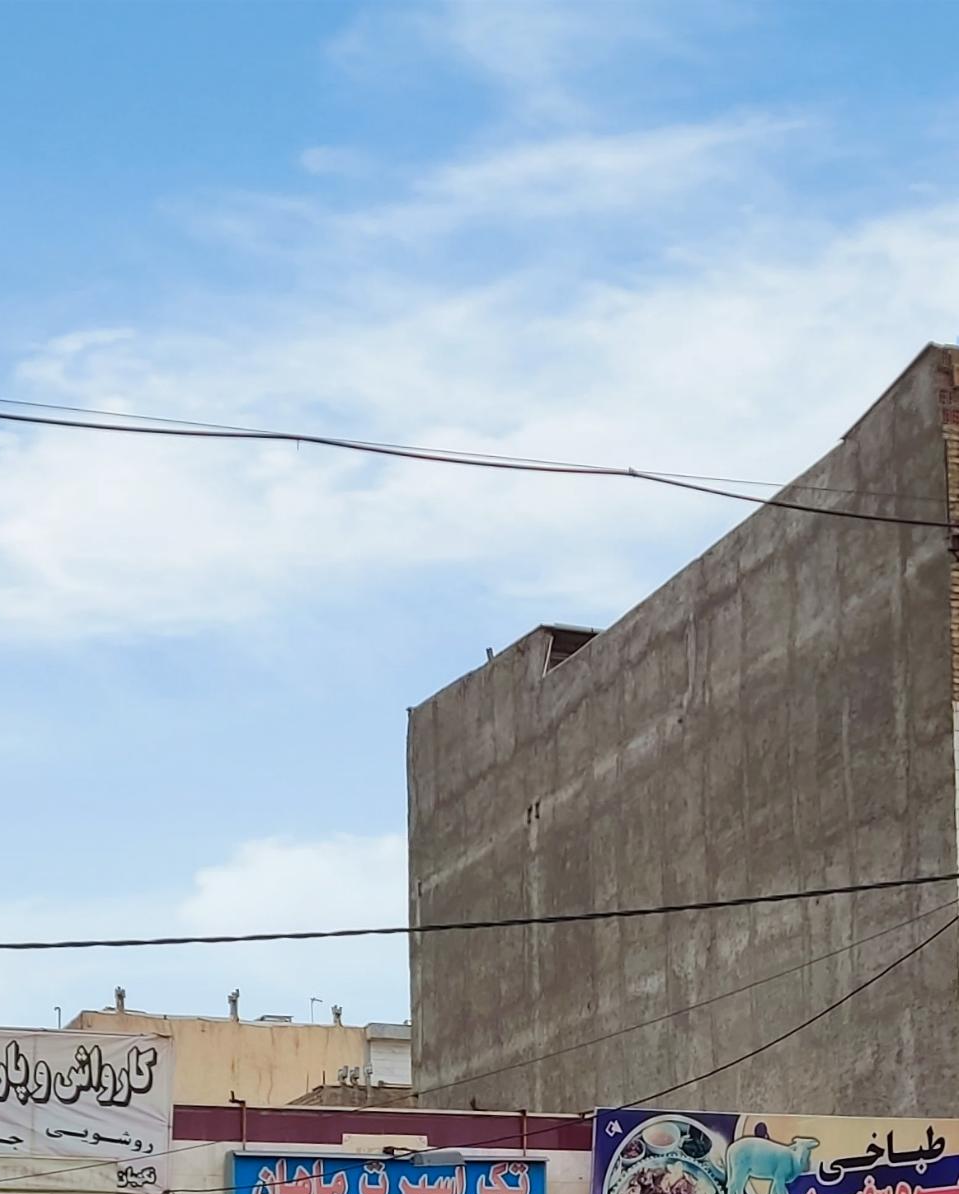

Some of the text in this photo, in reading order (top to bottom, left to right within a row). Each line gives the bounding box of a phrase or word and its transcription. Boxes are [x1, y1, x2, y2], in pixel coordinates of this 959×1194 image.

[31, 1057, 52, 1104] و
[53, 1045, 158, 1107] کارواش
[45, 1123, 155, 1155] روشویی
[817, 1125, 946, 1185] طباخی
